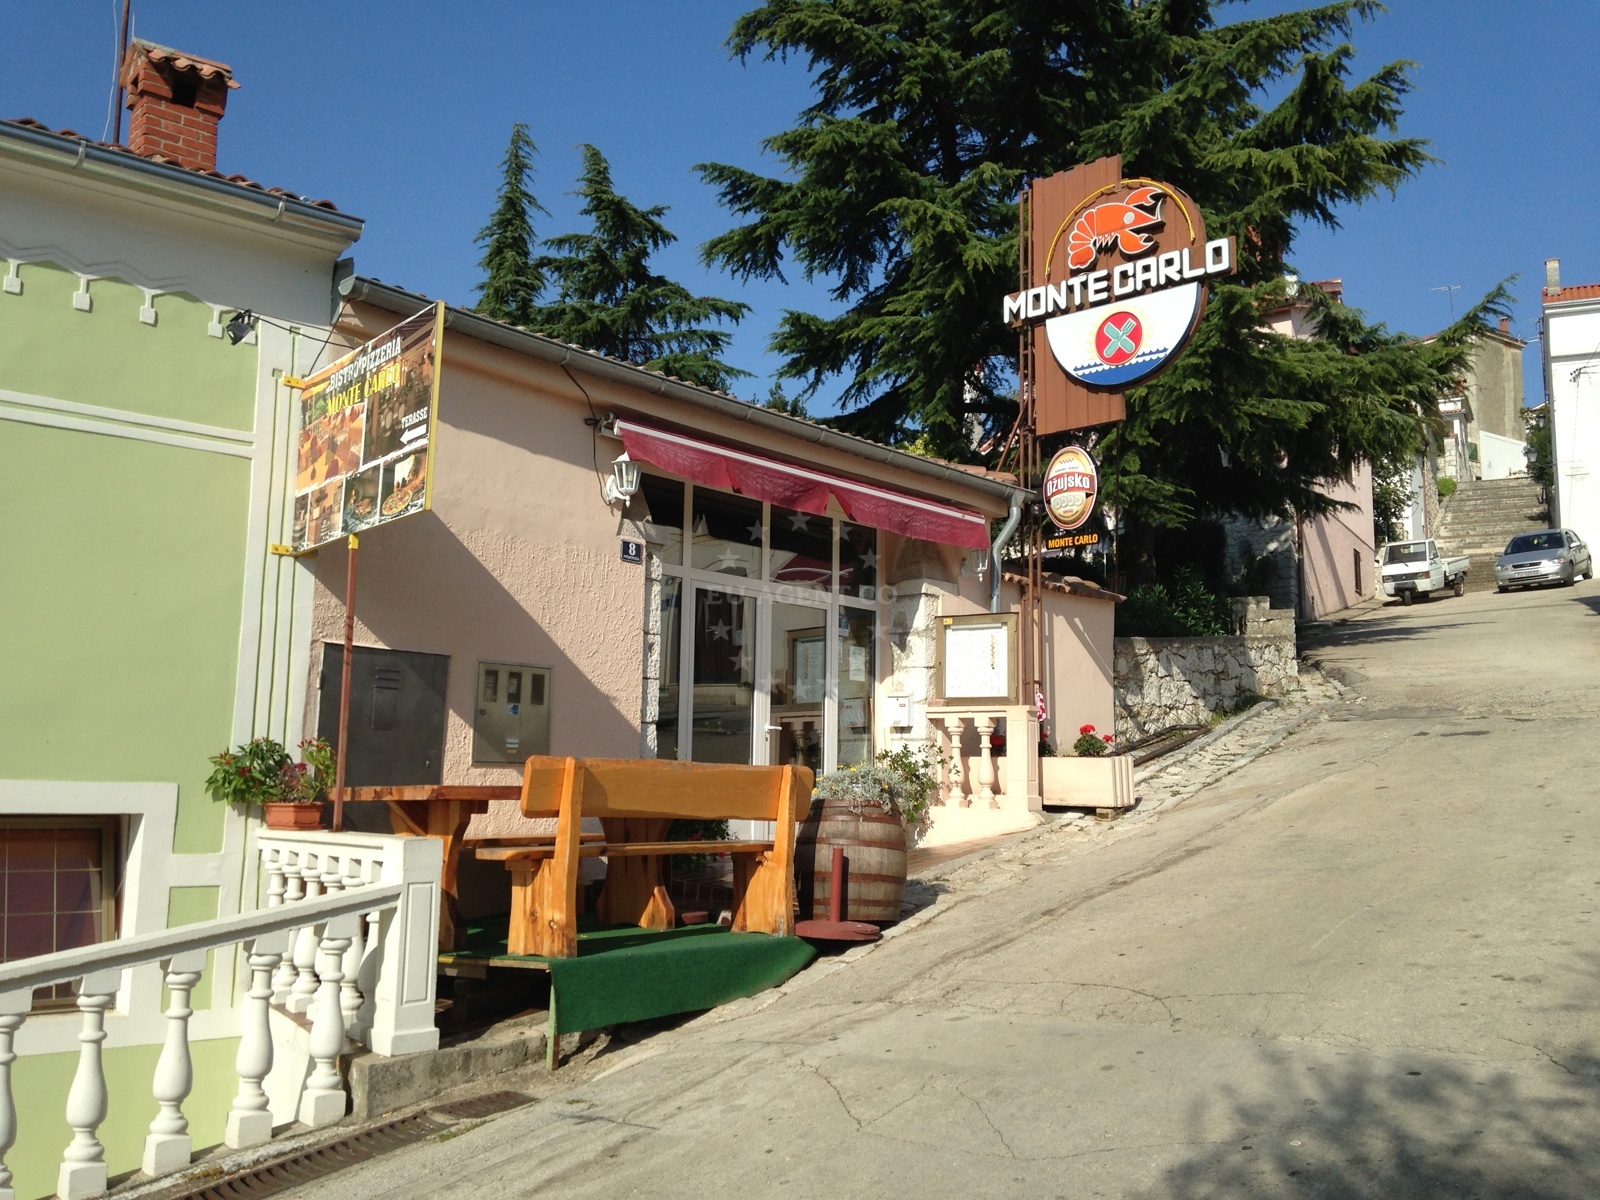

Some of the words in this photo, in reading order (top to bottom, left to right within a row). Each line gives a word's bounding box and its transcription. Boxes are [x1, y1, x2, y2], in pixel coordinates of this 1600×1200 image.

[1003, 269, 1108, 323] MONTE
[1113, 238, 1230, 296] CARLO
[361, 336, 401, 374] PIZZERIA
[327, 383, 361, 416] MONTE
[364, 363, 400, 397] CARLO
[401, 406, 428, 429] TERASSE
[1046, 473, 1091, 496] Ožujsko
[628, 542, 637, 556] 8
[1048, 536, 1073, 549] MONTE
[1074, 533, 1098, 545] CARLO
